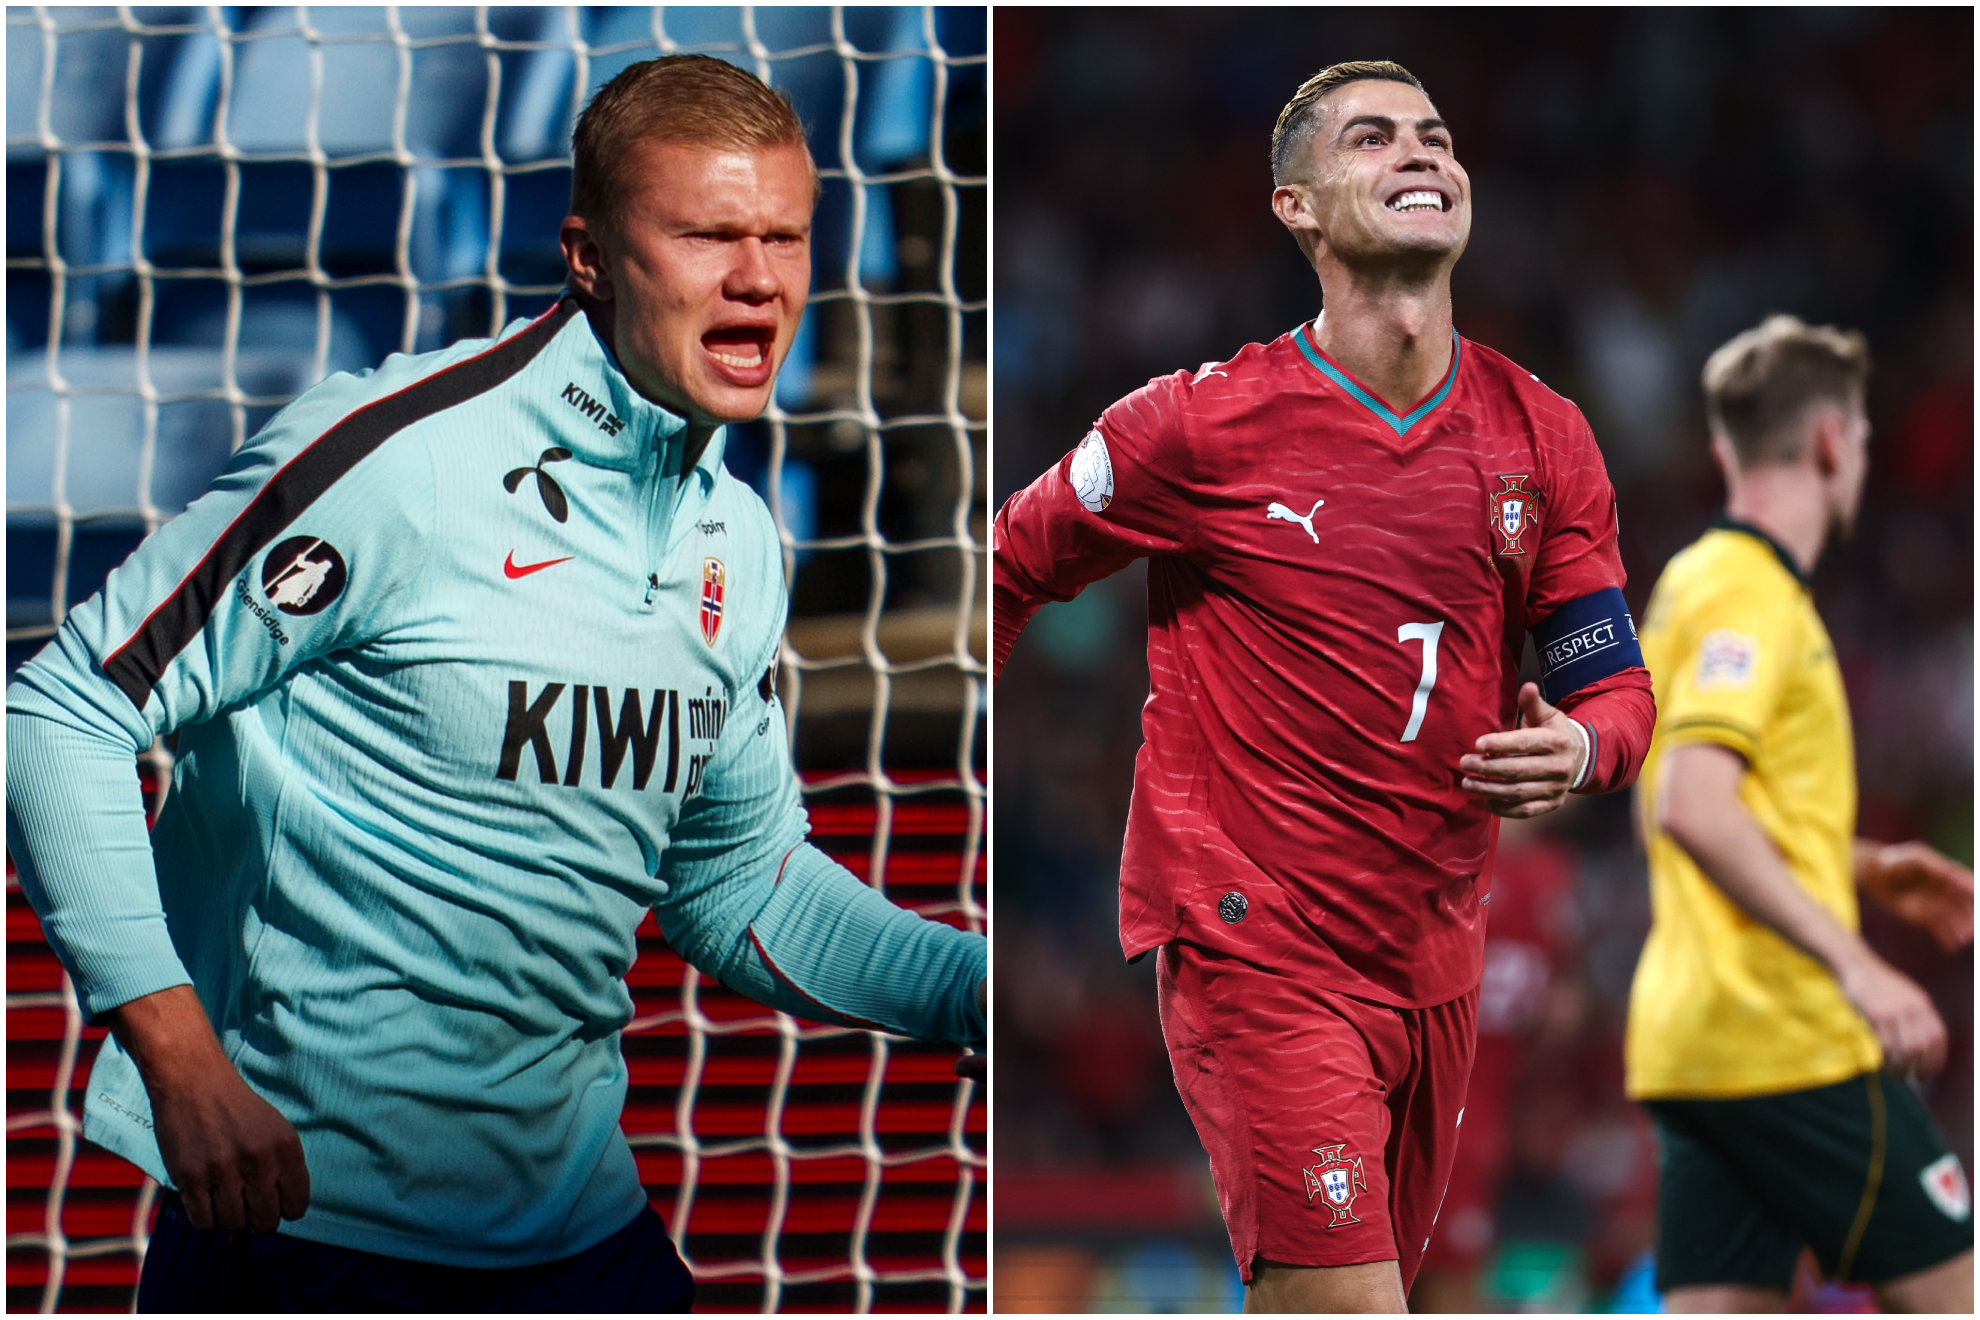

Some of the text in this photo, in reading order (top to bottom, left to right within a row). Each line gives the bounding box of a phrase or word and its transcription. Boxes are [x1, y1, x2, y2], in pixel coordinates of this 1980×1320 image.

[561, 382, 607, 423] KIWI
[237, 579, 289, 646] Gjensidige
[1546, 624, 1614, 666] RESPECT
[1397, 620, 1445, 742] 7
[496, 680, 680, 793] KIWI
